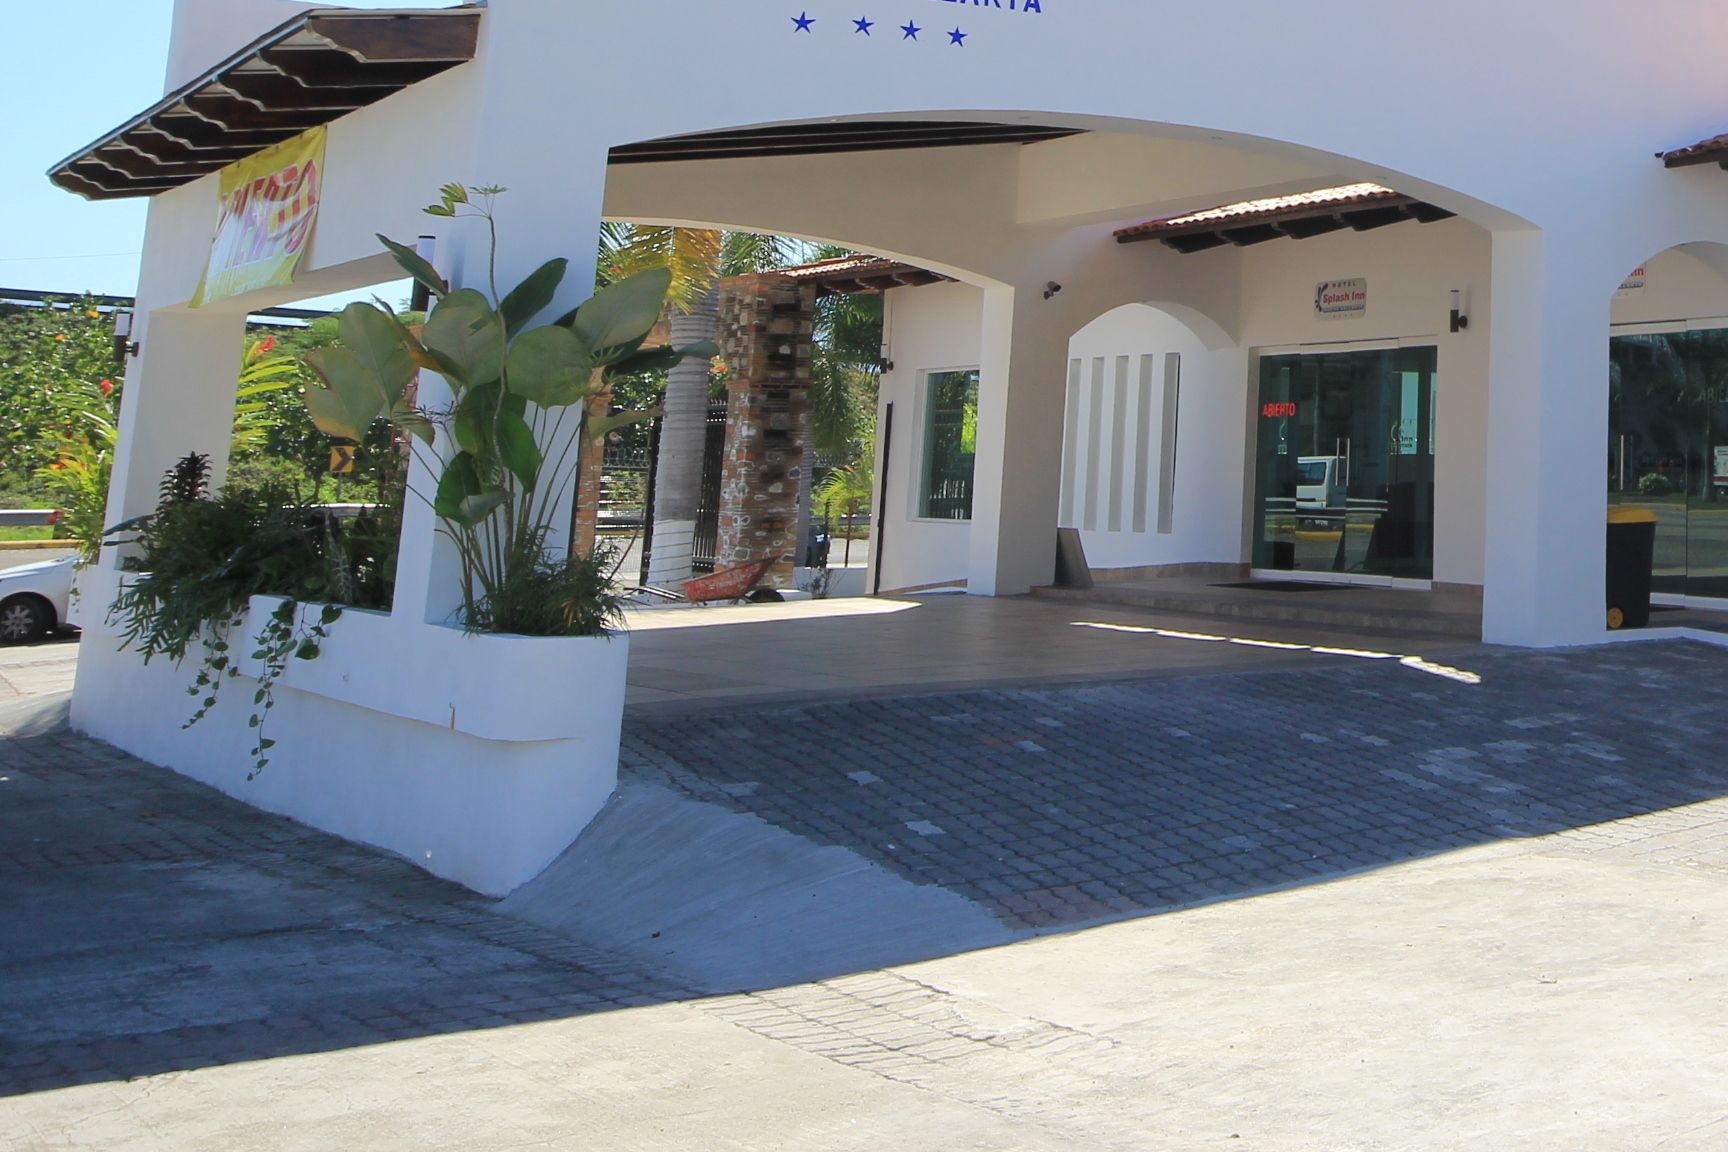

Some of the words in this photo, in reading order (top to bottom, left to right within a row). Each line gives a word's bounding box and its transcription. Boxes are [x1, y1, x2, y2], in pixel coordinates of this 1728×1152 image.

[1323, 292, 1350, 305] Splash
[1352, 291, 1366, 301] Inn
[1262, 402, 1296, 417] ABIERTO
